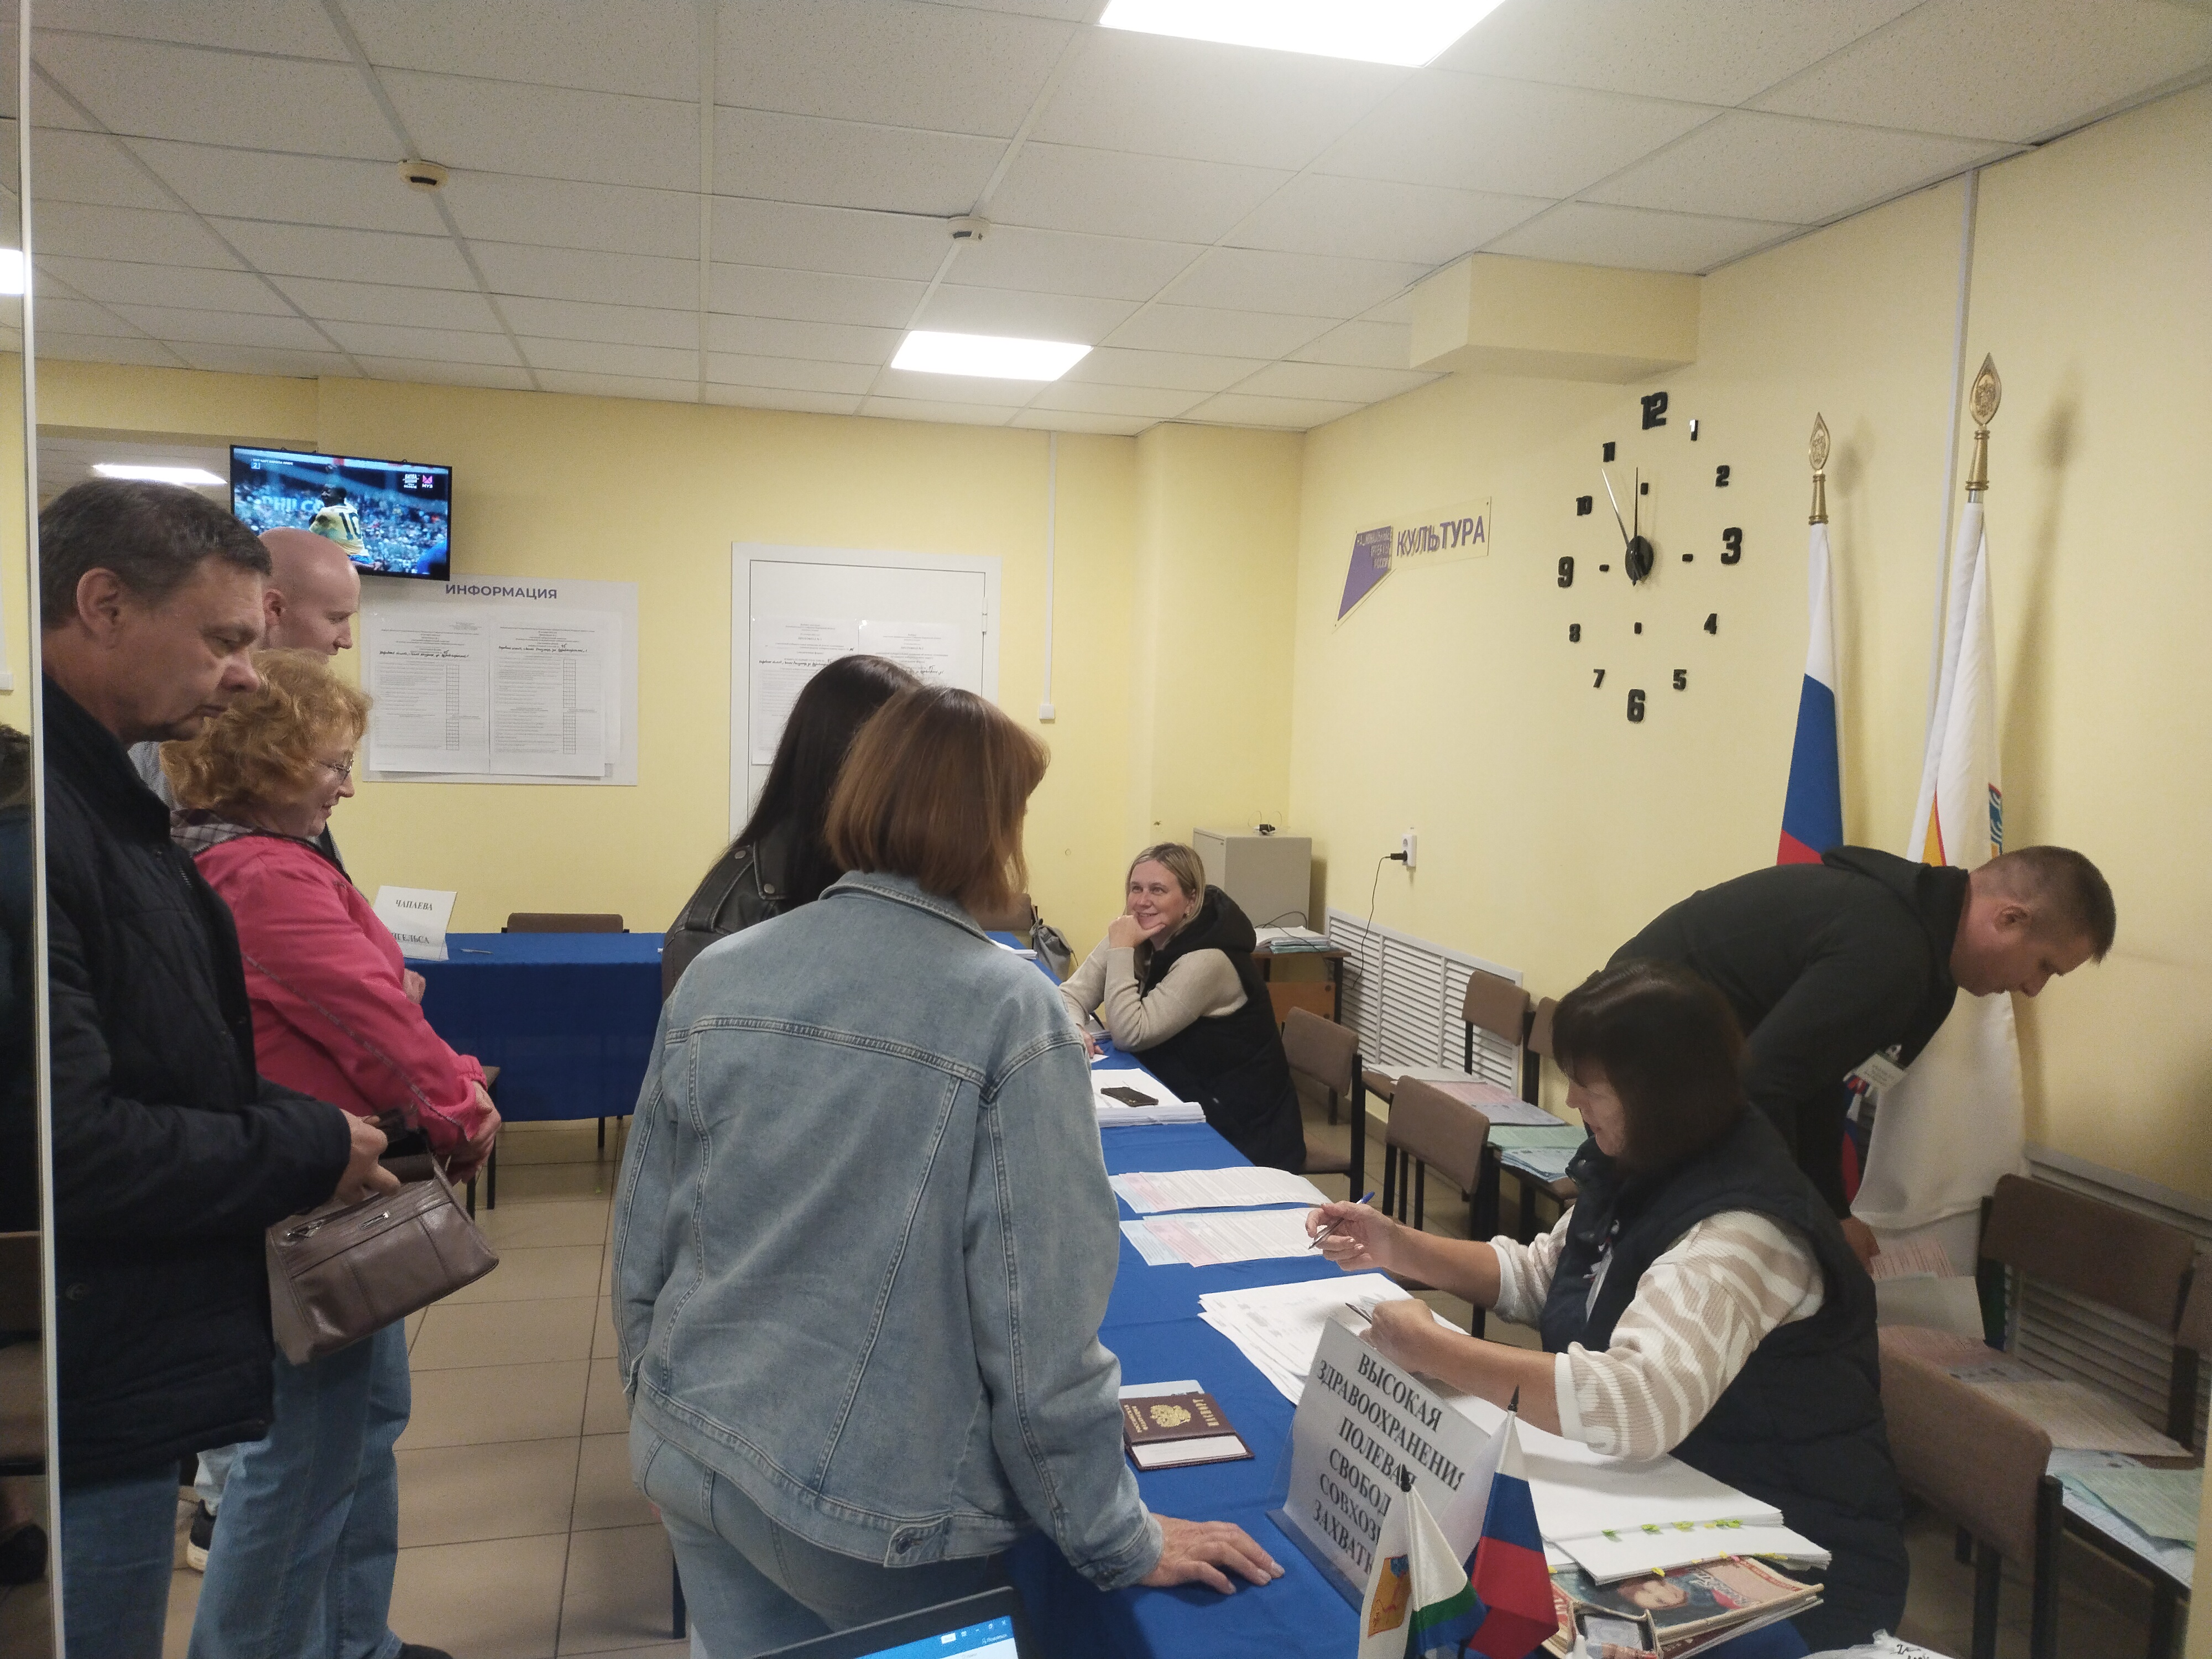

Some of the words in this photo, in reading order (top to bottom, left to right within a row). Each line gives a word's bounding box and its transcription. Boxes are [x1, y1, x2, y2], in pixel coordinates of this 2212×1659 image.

[1641, 392, 1668, 430] 12
[1689, 419, 1698, 441] 1
[1603, 442, 1615, 462] 11
[1715, 465, 1730, 487] 2
[1576, 496, 1592, 516] 10
[339, 512, 362, 540] 10
[1396, 515, 1485, 557] КУЛЬТУРА
[1721, 527, 1742, 565] 3
[1557, 556, 1574, 588] 9
[446, 584, 557, 600] ИНФОРМАЦИЯ
[1569, 624, 1580, 642] 8
[1704, 613, 1717, 634] 4
[1593, 669, 1604, 688] 7
[1673, 669, 1687, 690] 5
[1627, 689, 1645, 722] 6
[396, 900, 432, 911] ЧАПАЕВА
[391, 932, 430, 944] НГЕЛЬСА
[1358, 1353, 1442, 1433] ВЫСОКАЯ
[1329, 1448, 1391, 1516] СВОБОД
[1320, 1473, 1381, 1545] СОВХОЗ
